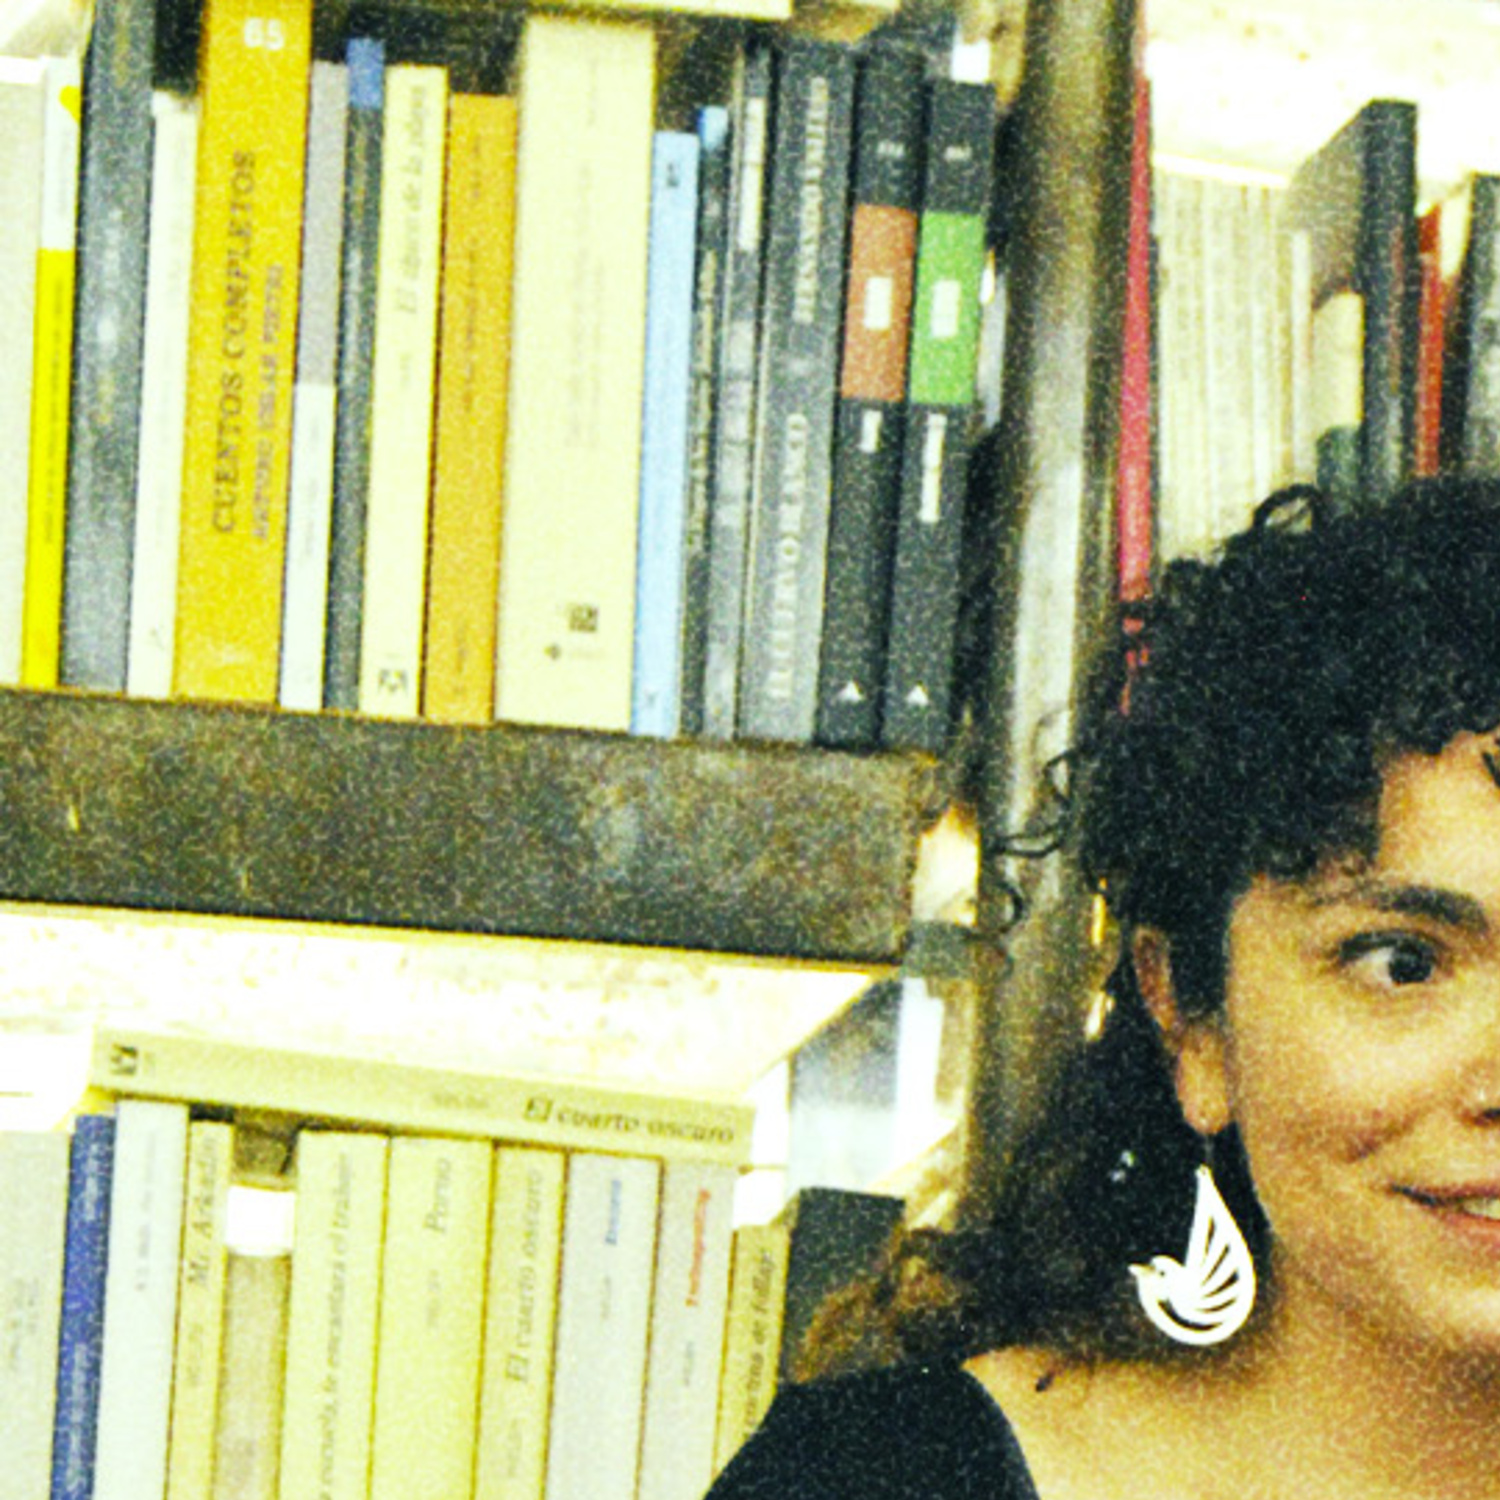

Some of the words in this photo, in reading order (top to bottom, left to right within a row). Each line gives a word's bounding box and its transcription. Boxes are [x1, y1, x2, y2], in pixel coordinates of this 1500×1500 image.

[219, 149, 256, 359] COMPLETOS
[211, 371, 245, 534] CUENTOS
[523, 1096, 555, 1123] El
[556, 1105, 641, 1131] cuarto
[648, 1117, 736, 1144] oscuro
[421, 1156, 453, 1235] Porno
[519, 1166, 543, 1260] oscuro
[513, 1265, 537, 1349] cuarto
[504, 1353, 530, 1384] El
